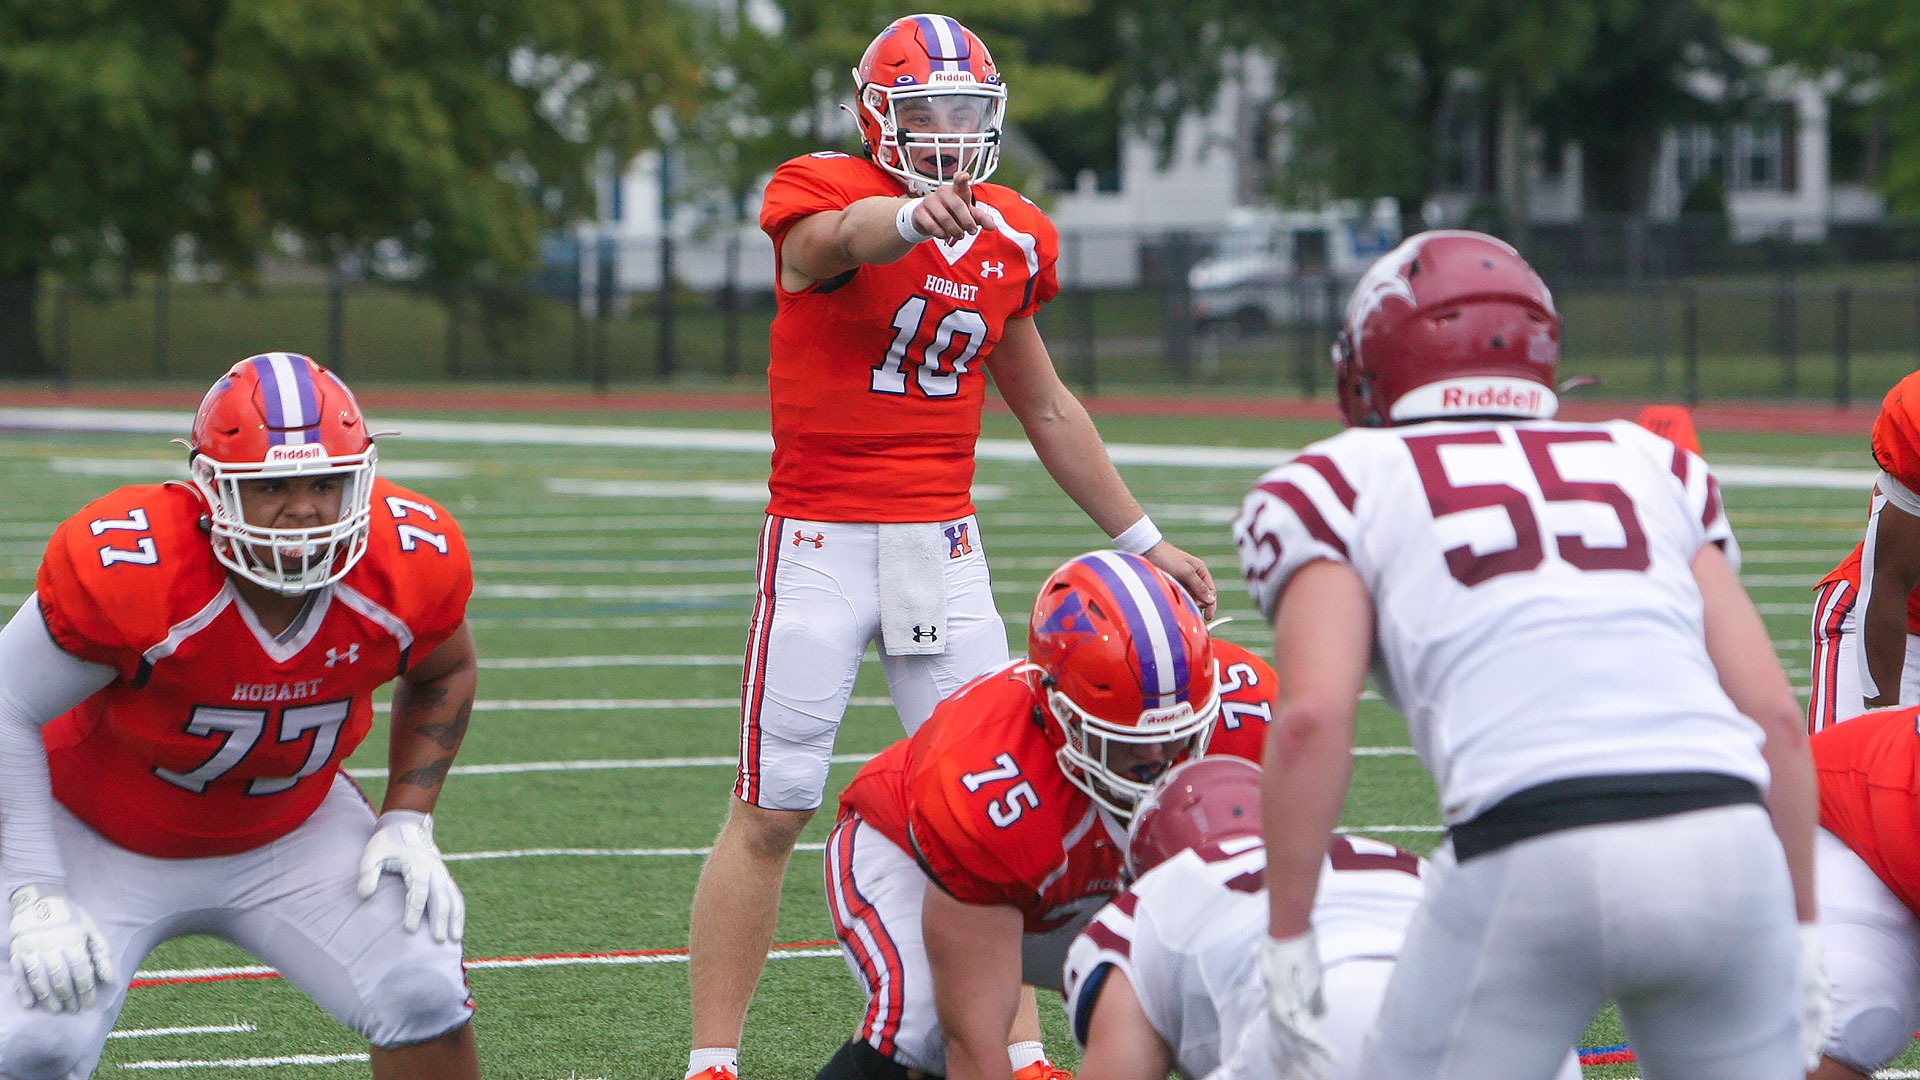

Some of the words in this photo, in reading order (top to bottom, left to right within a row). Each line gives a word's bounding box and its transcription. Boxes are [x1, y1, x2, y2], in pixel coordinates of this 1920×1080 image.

[935, 73, 971, 82] Riddell
[923, 274, 979, 302] HOBART
[868, 294, 989, 398] 10
[1443, 386, 1542, 411] Riddell
[273, 448, 320, 460] Riddell
[89, 507, 160, 568] 77
[384, 495, 449, 555] 77
[1400, 429, 1652, 588] 55
[944, 522, 973, 560] H
[231, 678, 324, 702] HOBART
[1218, 661, 1274, 731] 75
[150, 696, 354, 798] 77
[960, 752, 1041, 829] 75
